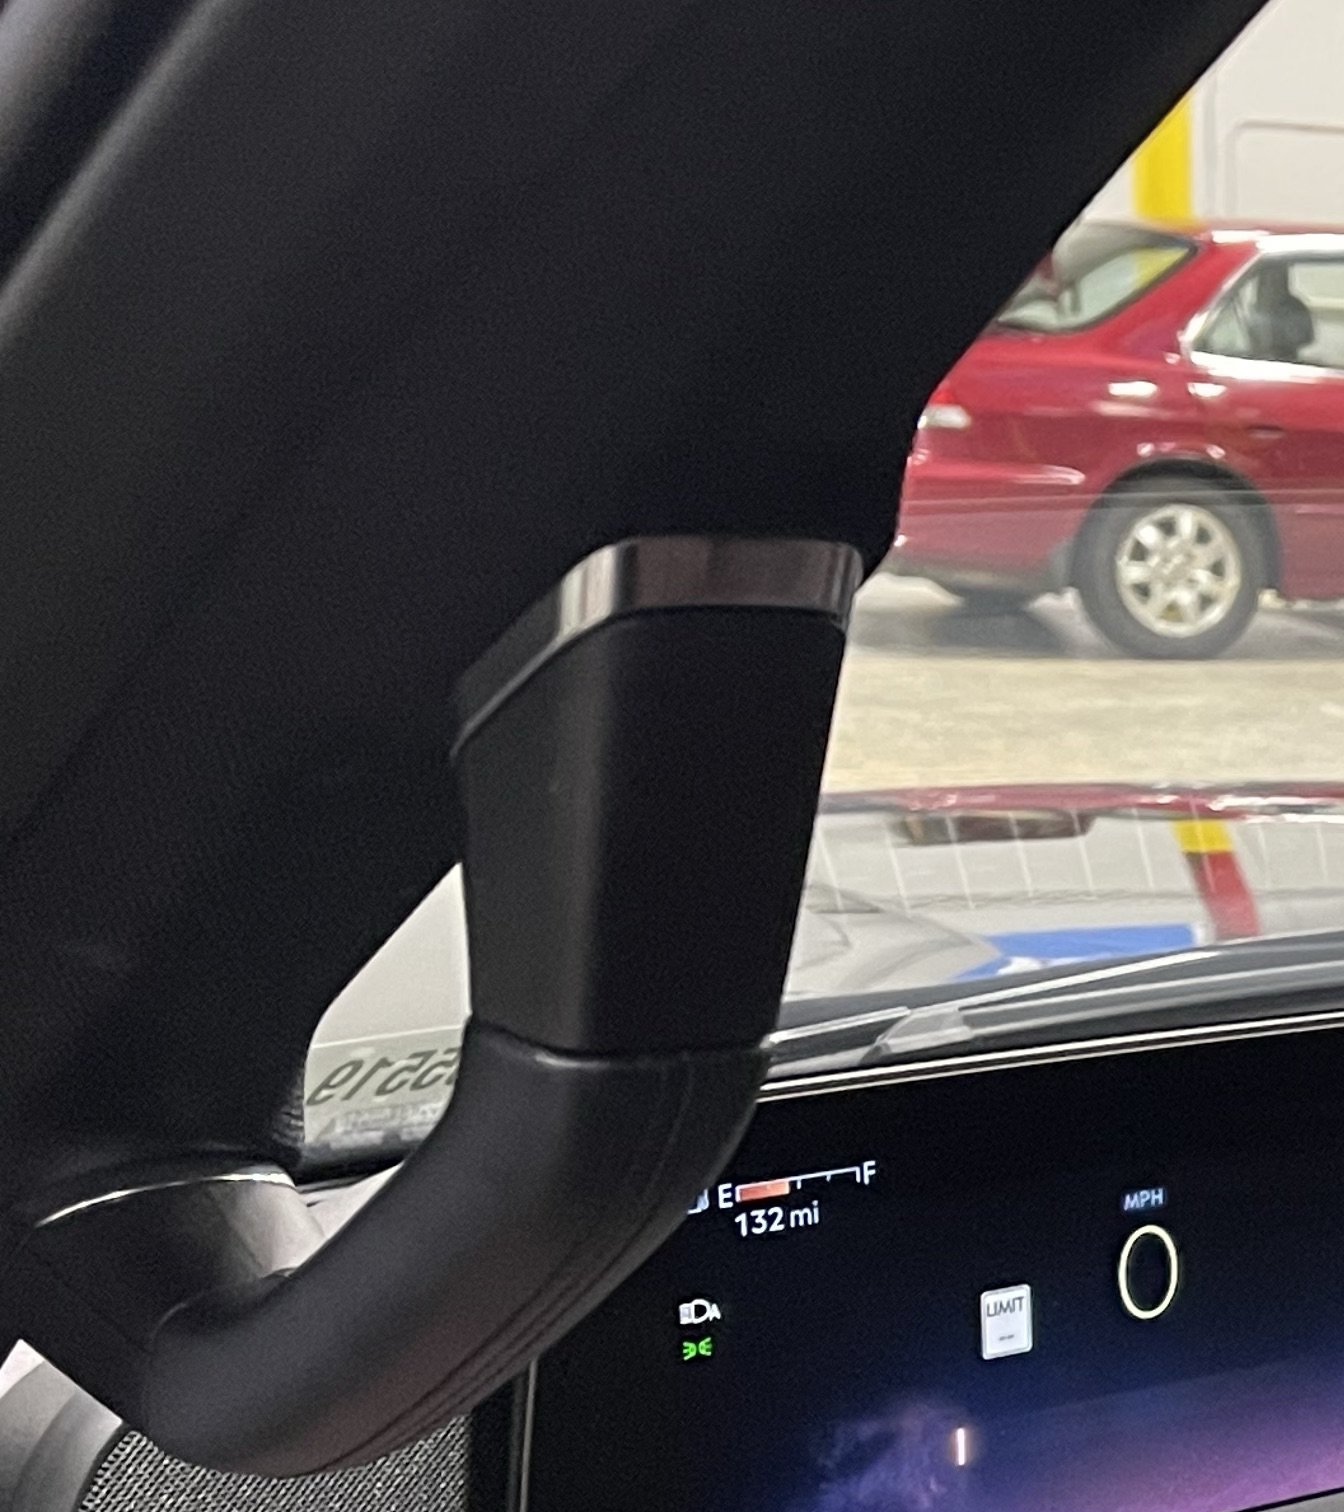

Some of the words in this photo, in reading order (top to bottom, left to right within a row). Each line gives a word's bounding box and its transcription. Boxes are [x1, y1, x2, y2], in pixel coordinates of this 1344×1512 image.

[718, 1183, 735, 1209] E
[1123, 1188, 1165, 1211] MPH
[734, 1206, 785, 1237] 132
[790, 1201, 820, 1227] mi
[1118, 1224, 1179, 1320] 0
[986, 1295, 1025, 1318] LIMIT
